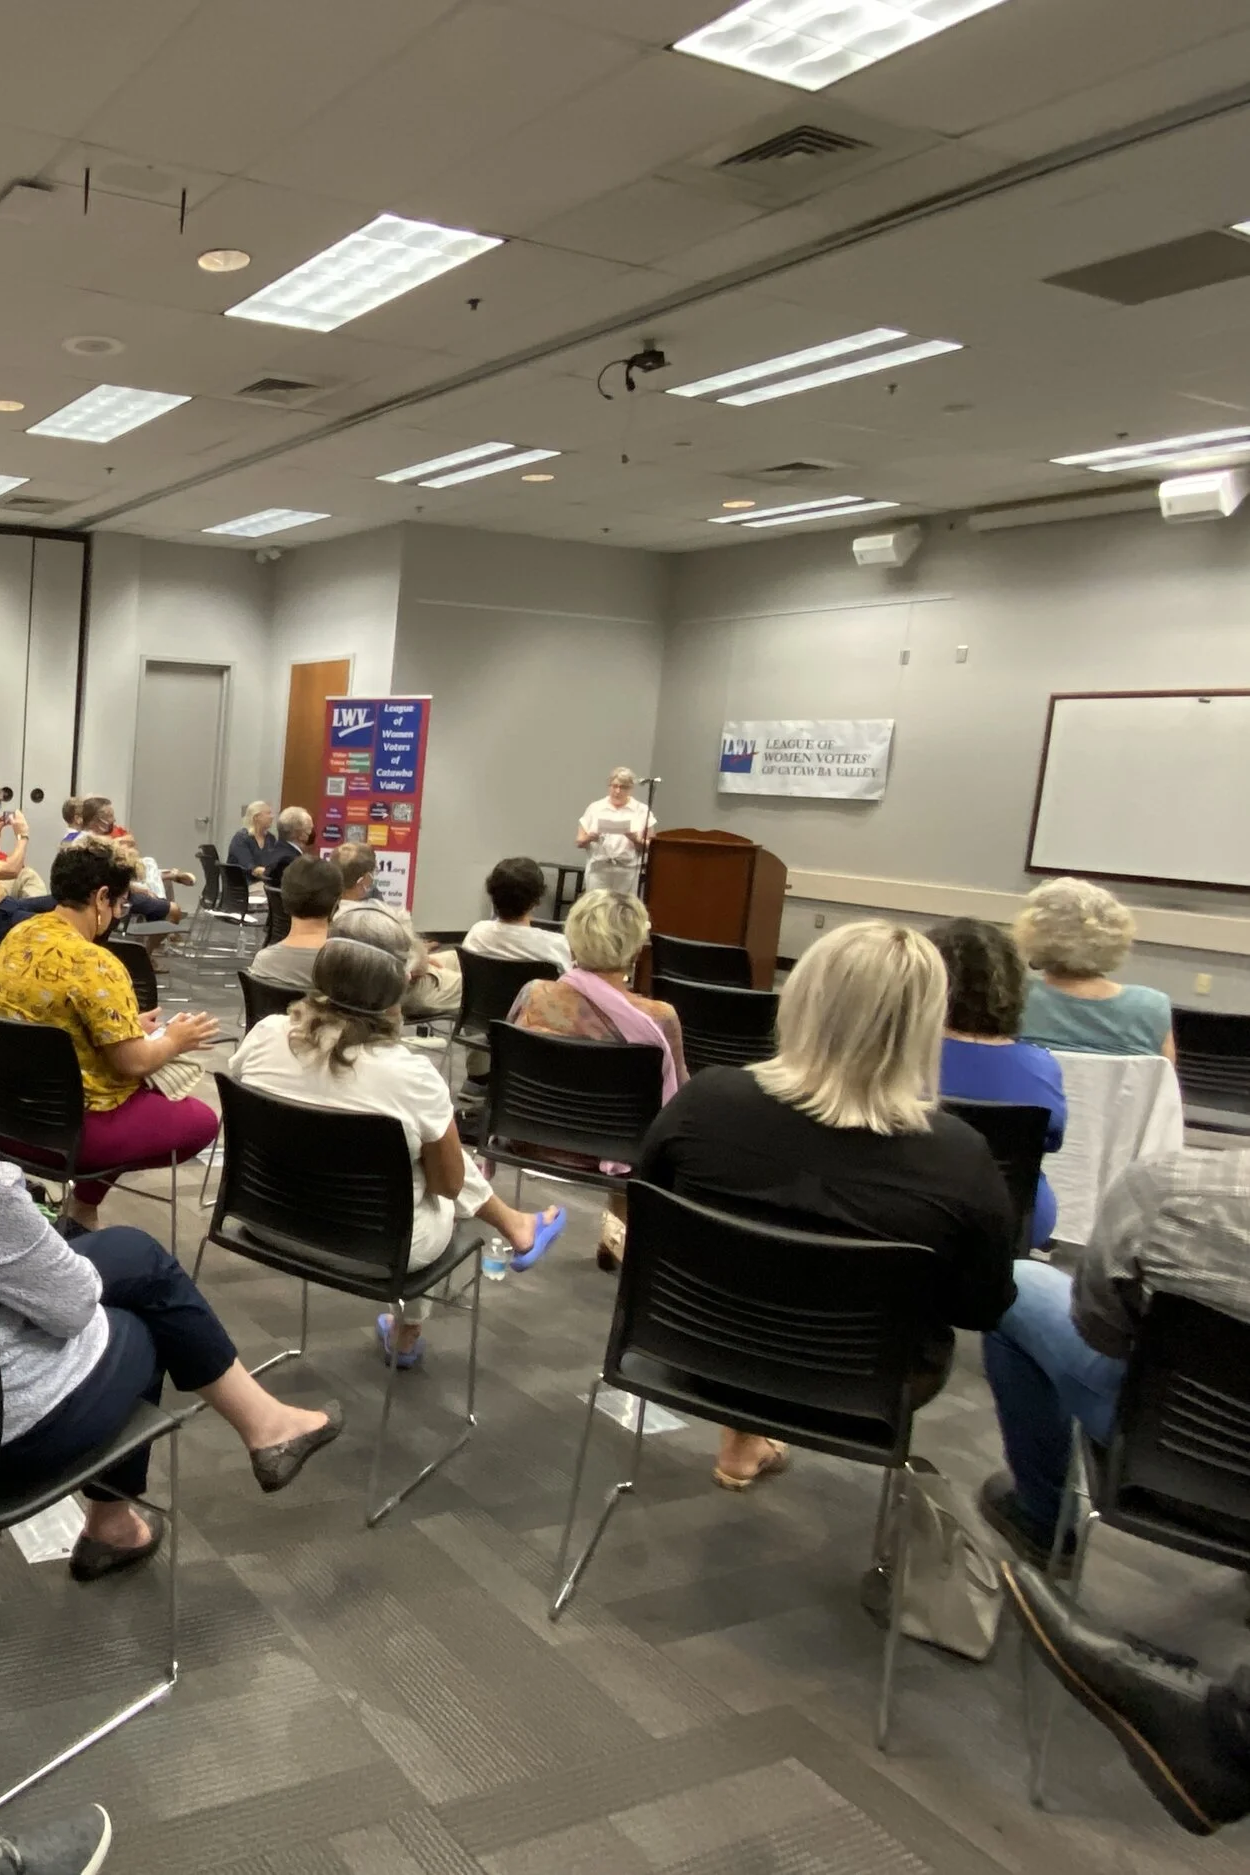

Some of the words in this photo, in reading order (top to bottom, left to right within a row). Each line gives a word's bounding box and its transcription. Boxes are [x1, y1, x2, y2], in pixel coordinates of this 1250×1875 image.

[384, 704, 414, 714] League
[332, 708, 367, 727] LWV
[393, 717, 403, 726] of
[382, 730, 414, 738] Women
[383, 743, 410, 751] Voters
[765, 739, 814, 750] LEAGUE
[817, 739, 835, 750] OF
[391, 756, 401, 765] of
[764, 752, 812, 763] WOMEN
[376, 768, 413, 777] Catawba
[762, 765, 775, 775] OF
[778, 765, 832, 777] CATAWBA
[836, 767, 878, 778] VALLEY
[379, 781, 405, 791] Valley
